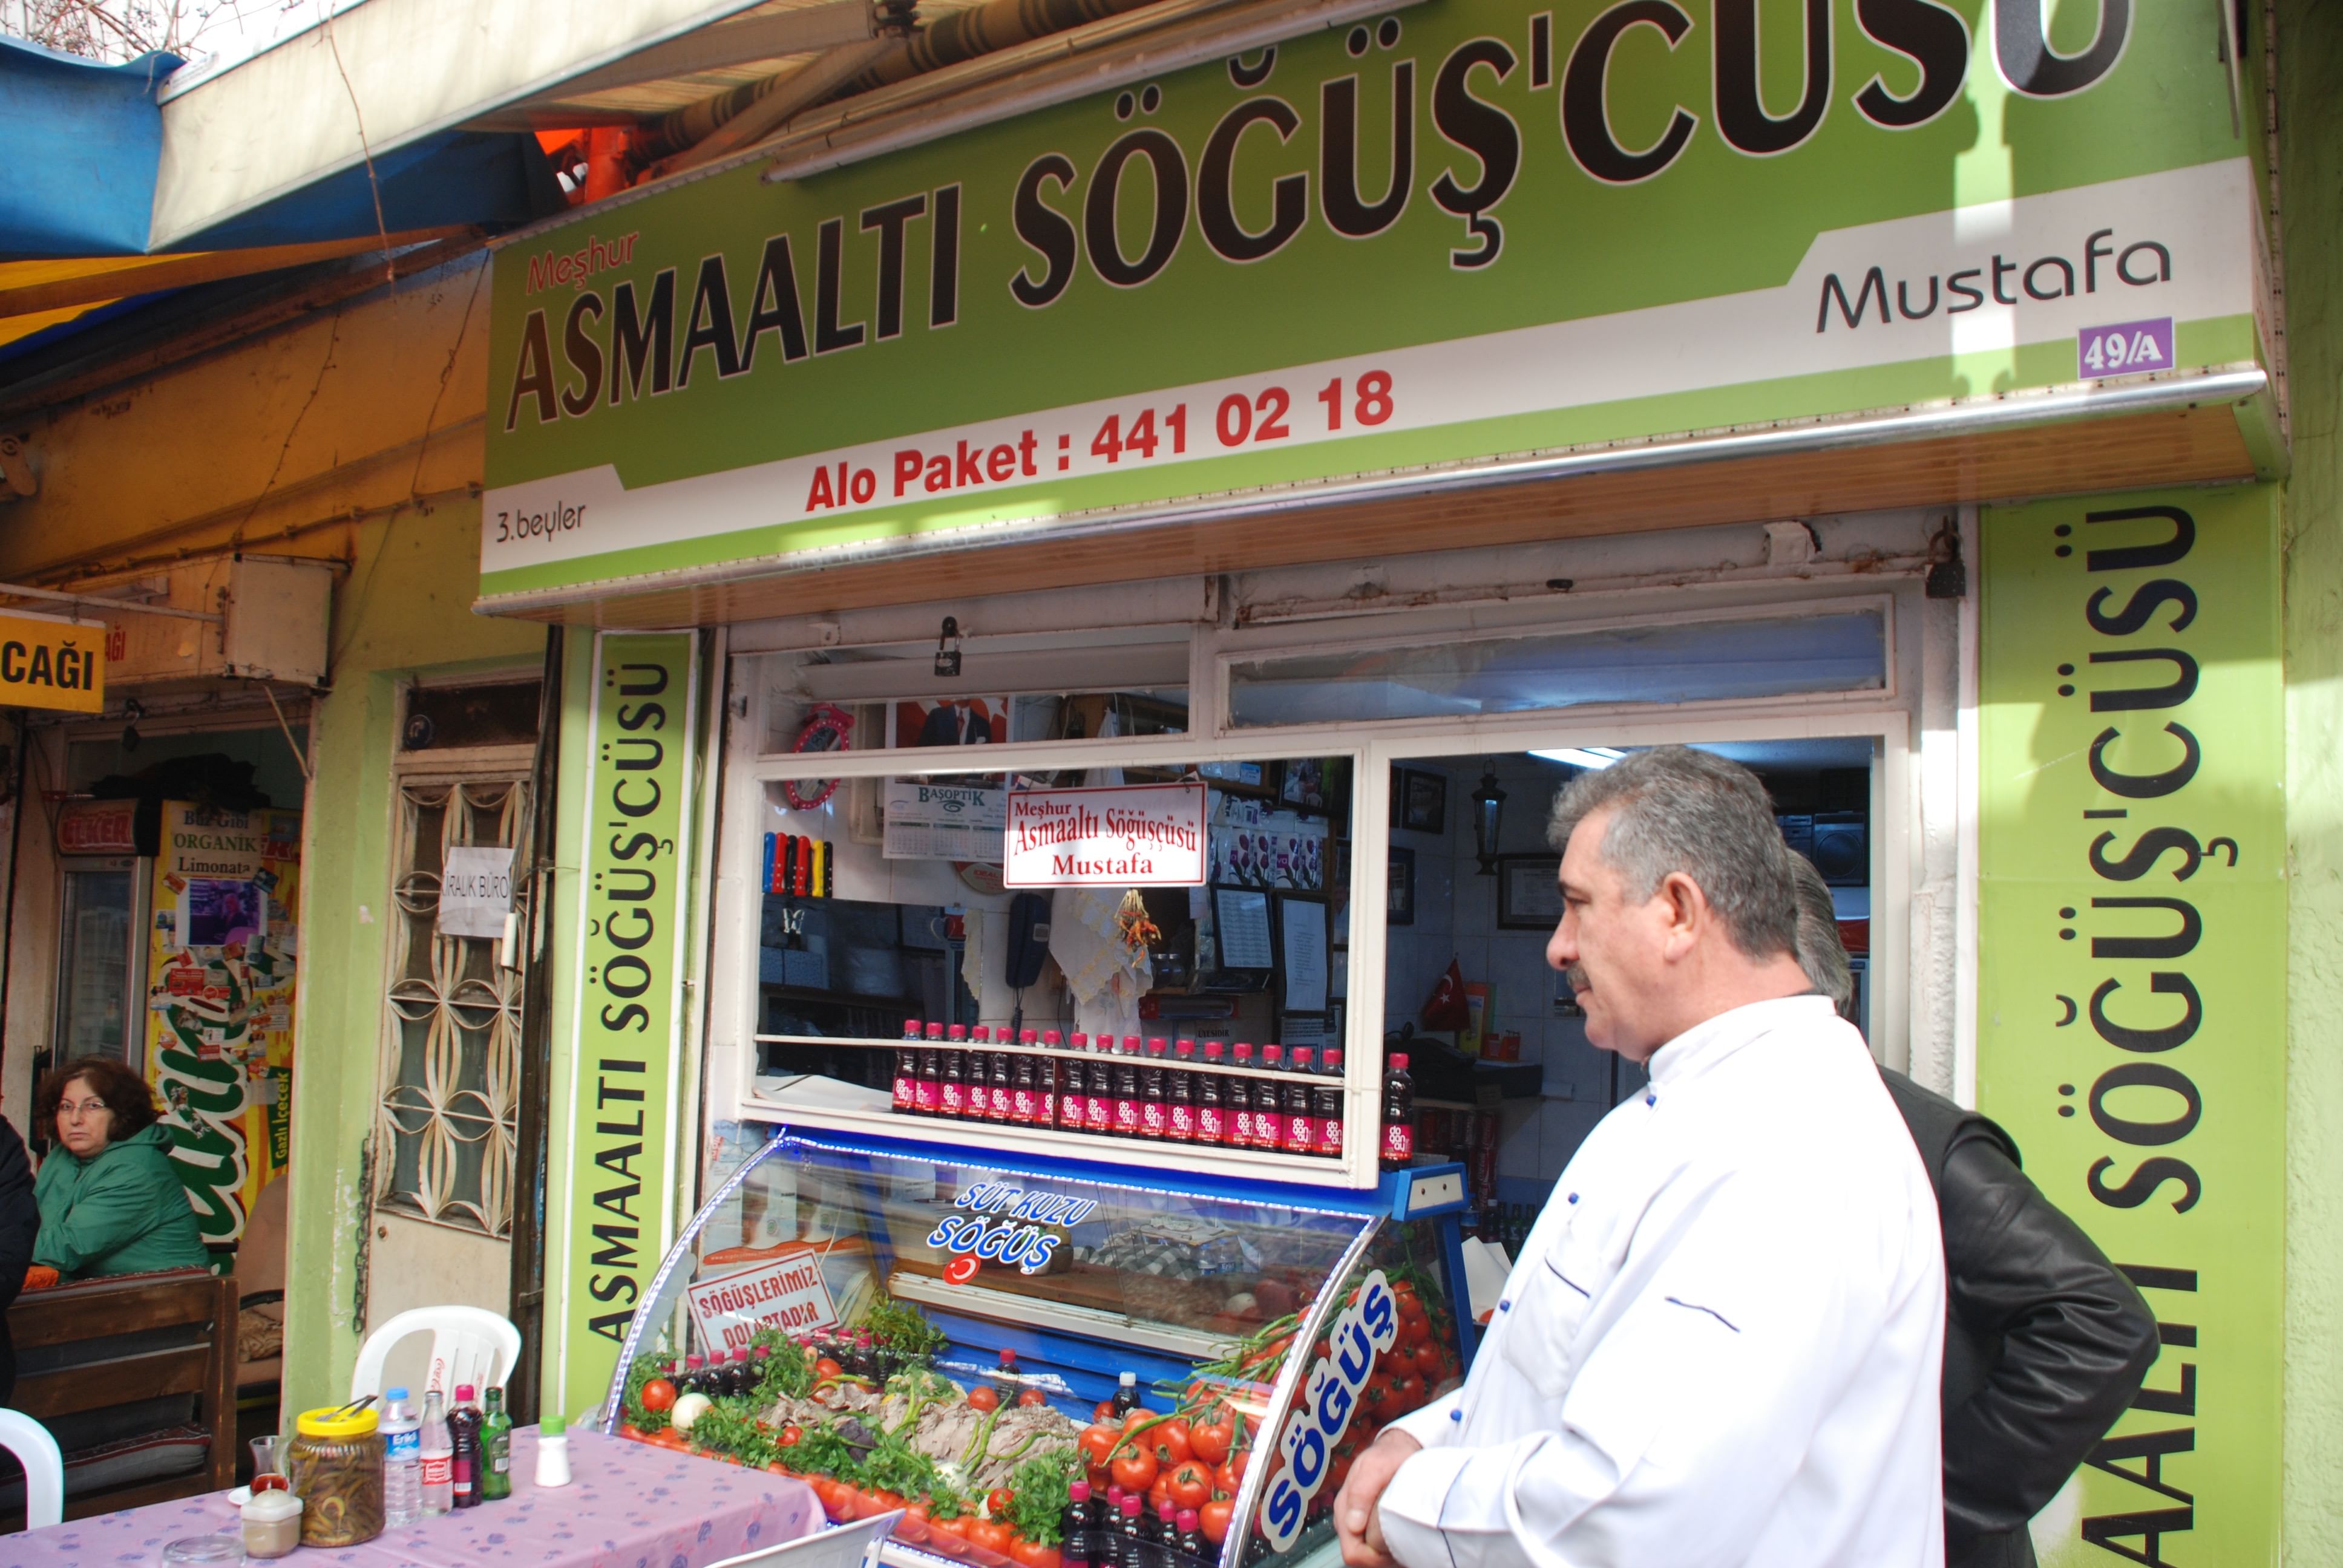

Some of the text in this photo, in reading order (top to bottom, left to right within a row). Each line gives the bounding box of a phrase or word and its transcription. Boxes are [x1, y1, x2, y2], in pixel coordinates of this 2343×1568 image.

[526, 231, 639, 291] Meşhur
[1816, 228, 2172, 333] Mustafa
[504, 181, 962, 434] ASMAALTI
[2083, 327, 2162, 370] 49/A
[805, 465, 876, 513] Alo
[893, 430, 1038, 502] Paket
[1091, 403, 1188, 466] 441
[1216, 386, 1290, 448] 02
[1318, 369, 1395, 432] 18
[1, 639, 94, 691] CAĞI
[1014, 804, 1099, 856] Asmaaltı
[1015, 800, 1072, 819] Meşhur
[479, 871, 509, 898] BÜRO
[1051, 852, 1153, 876] Mustafa
[2054, 505, 2238, 1215] SÖĞÜŞ'CÜSÜ
[588, 663, 673, 1344] ASMAALTI SÖĞÜŞ'CÜSÜ
[274, 1126, 288, 1158] Gazlı
[954, 1180, 1024, 1215] SÜT
[1008, 1189, 1098, 1227] KUZU
[926, 1215, 1061, 1275] SÖĞÜŞ
[698, 1264, 818, 1319] SÖĞÜŞLERİMİZ
[1268, 1283, 1394, 1538] SÖĞÜŞ
